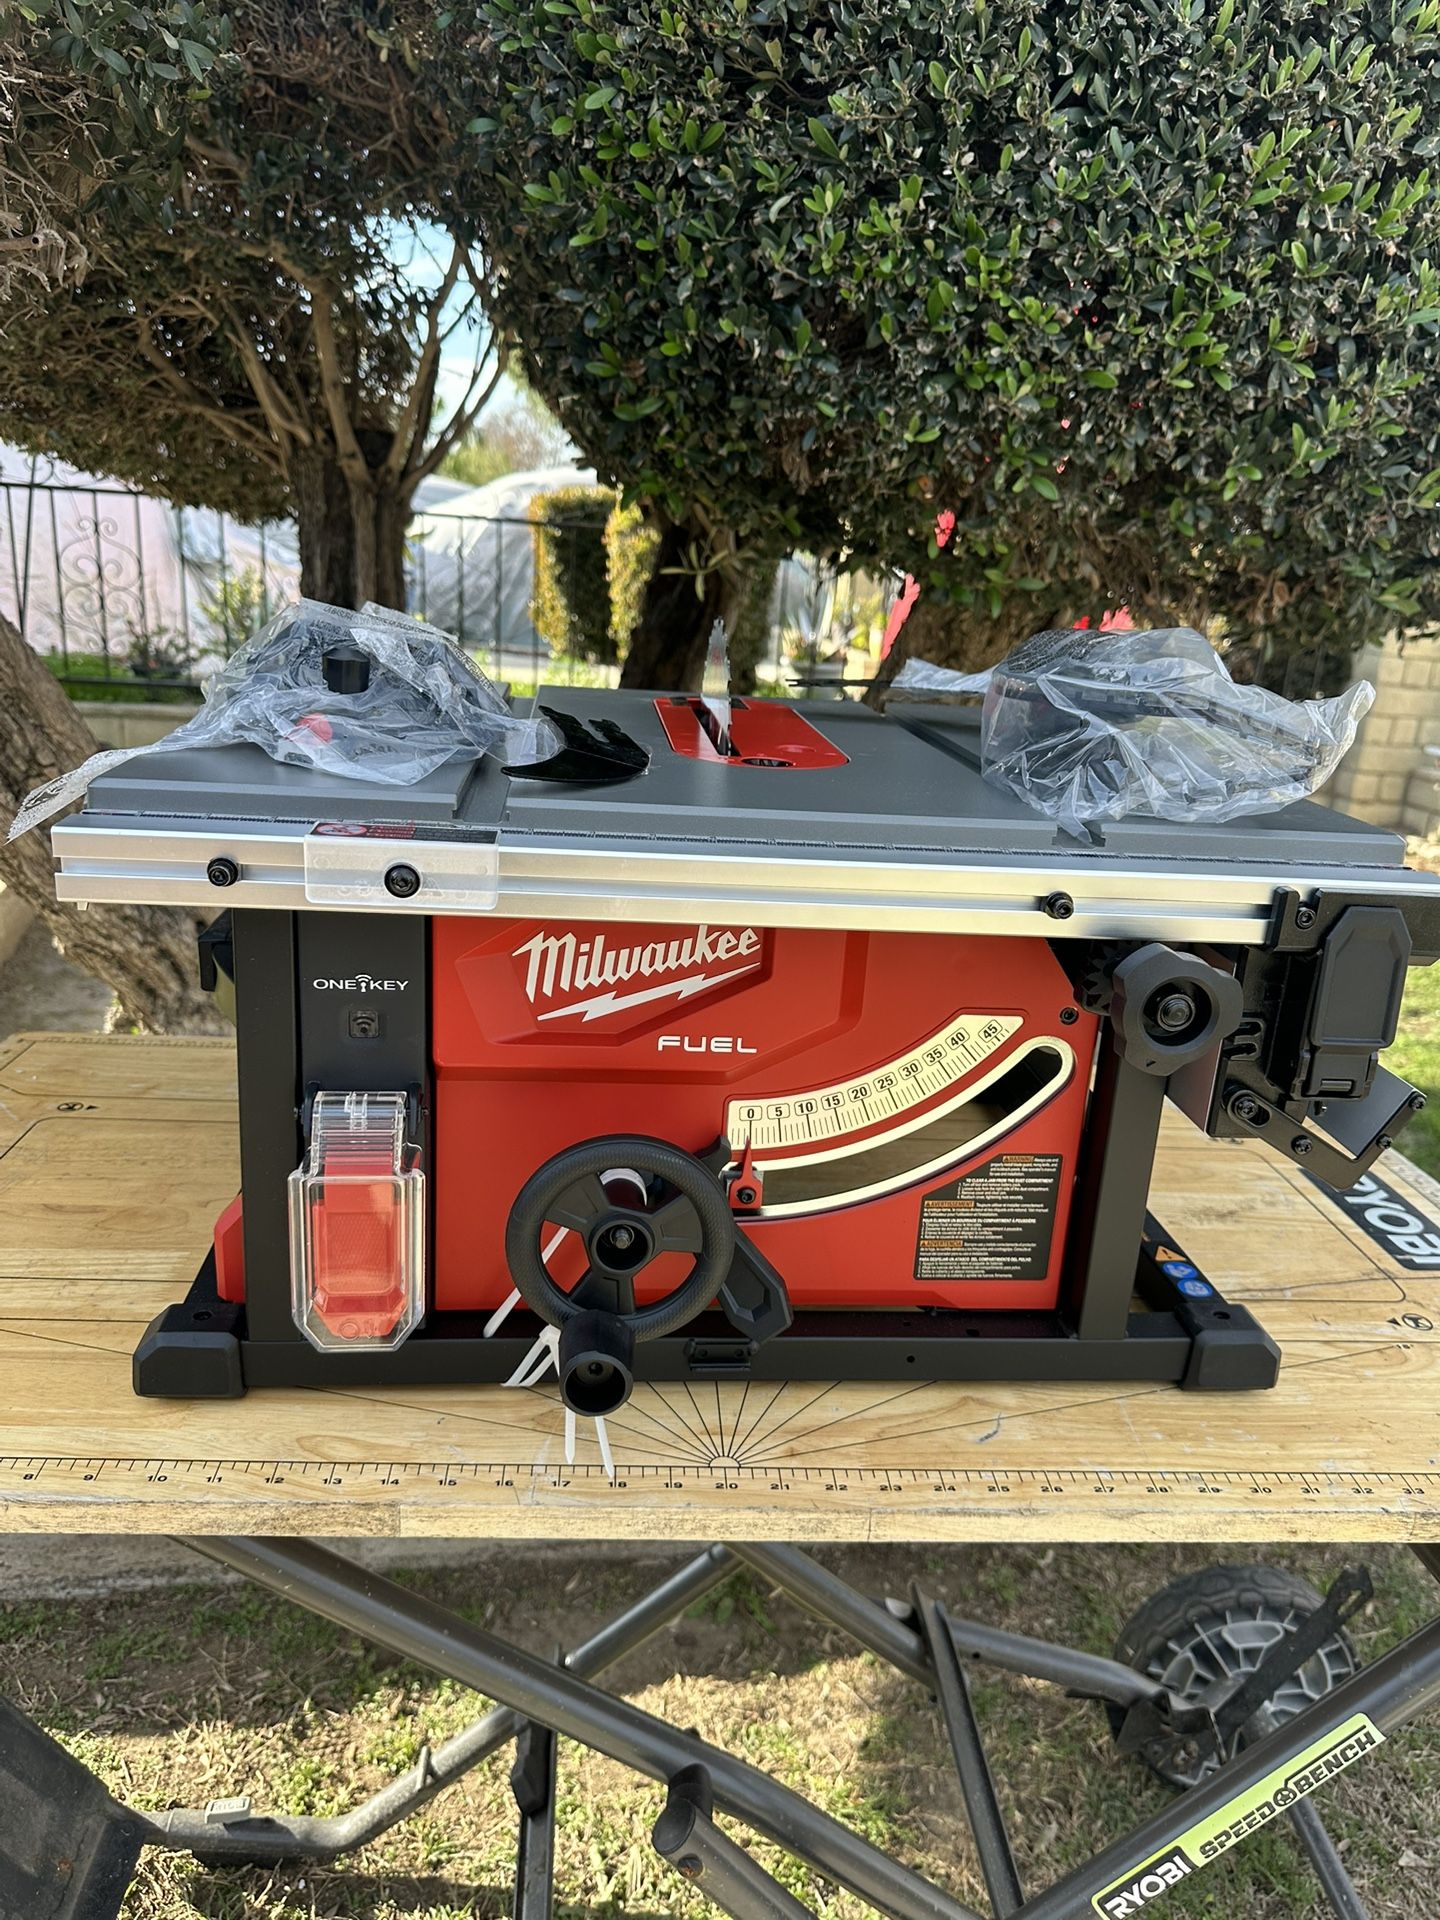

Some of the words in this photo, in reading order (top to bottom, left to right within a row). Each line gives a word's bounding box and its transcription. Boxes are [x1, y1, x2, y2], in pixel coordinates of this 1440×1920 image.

[313, 979, 357, 989] ONE
[370, 980, 409, 990] KEY
[512, 925, 760, 1003] Milwaukee
[658, 1035, 757, 1053] FUEL
[747, 1109, 755, 1119] 0
[775, 1107, 782, 1116] 5
[798, 1102, 814, 1114] 10
[824, 1095, 841, 1108] 15
[851, 1086, 868, 1100] 20
[877, 1076, 894, 1089] 25
[902, 1063, 919, 1077] 30
[926, 1048, 943, 1064] 35
[949, 1030, 967, 1047] 40
[982, 1023, 999, 1040] 45
[1200, 1800, 1276, 1859] SPEED
[1293, 1730, 1377, 1795] BENCH
[1104, 1855, 1192, 1920] RYOBI
